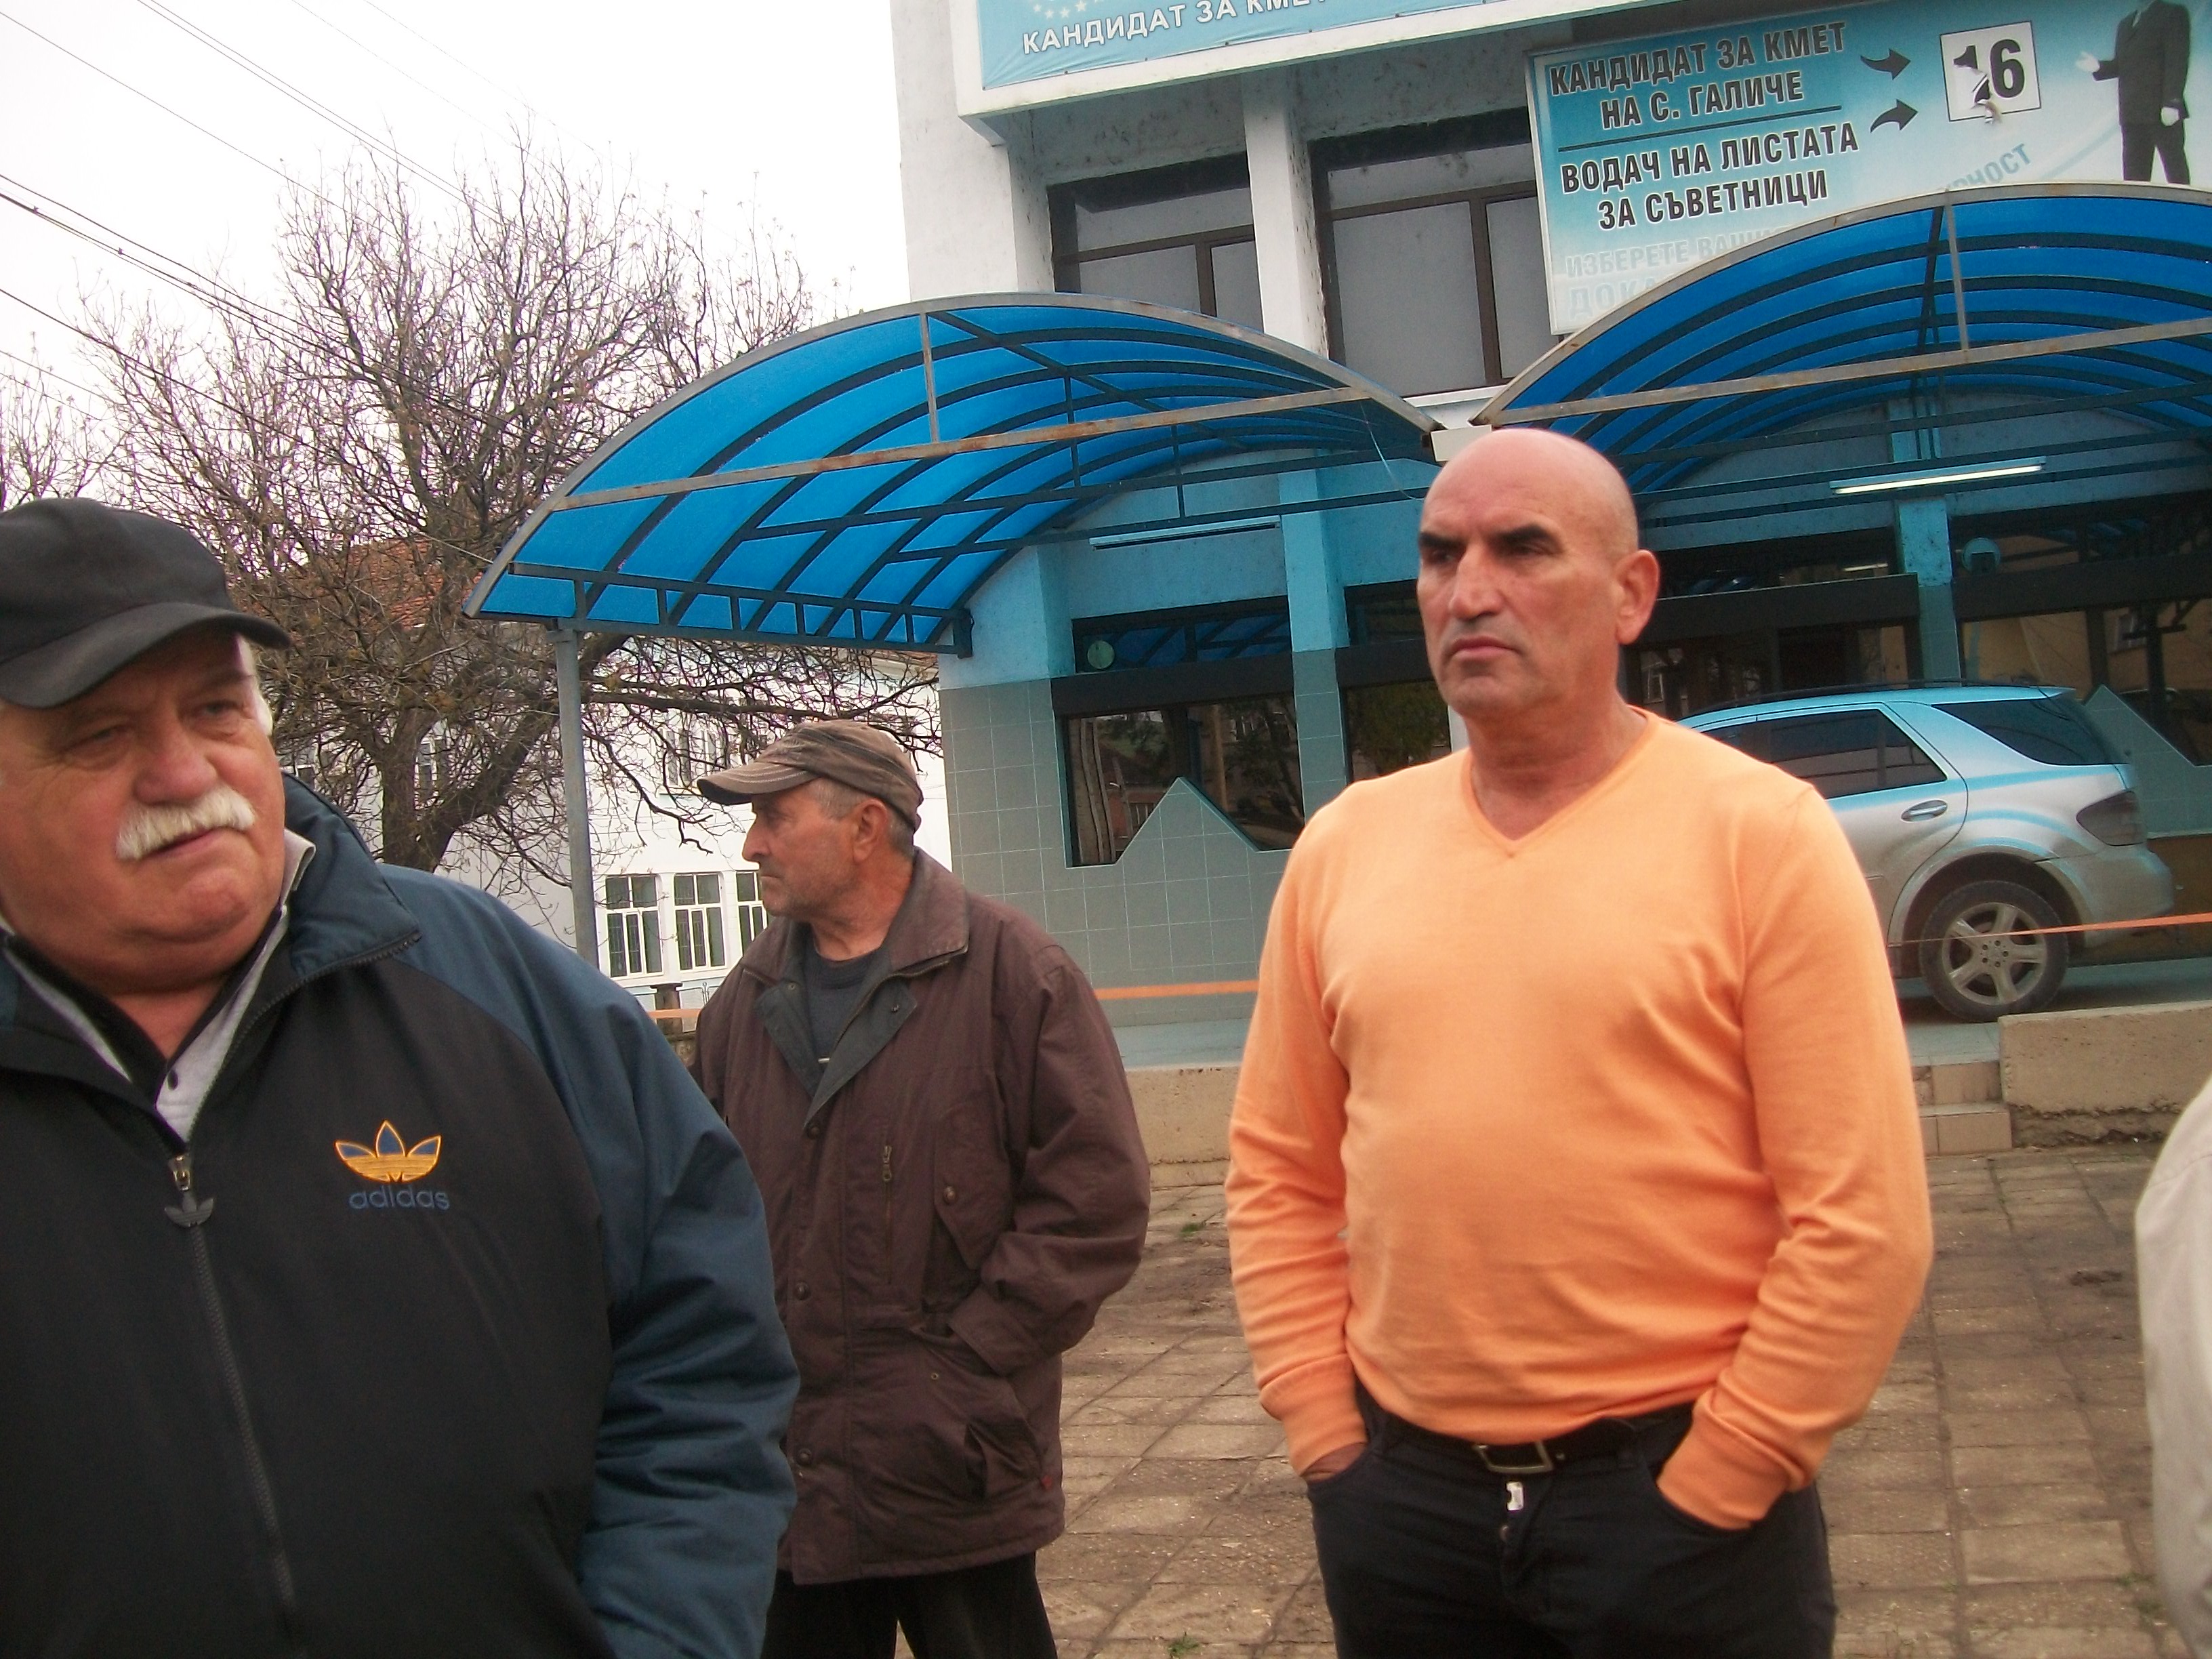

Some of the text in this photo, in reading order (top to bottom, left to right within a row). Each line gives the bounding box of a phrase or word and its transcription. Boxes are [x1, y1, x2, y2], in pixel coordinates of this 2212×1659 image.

[1022, 3, 1187, 54] КАНДИДАТ
[1195, 0, 1237, 23] ЗА
[1550, 22, 1846, 96] КАНДИДАТ ЗА КМЕТ
[1601, 71, 1803, 129] НА С. ГАЛИЧЕ
[1561, 122, 1858, 193] ВОДАЧ НА ЛИСТАТА
[1597, 169, 1828, 230] ЗА СЪВЕТНИЦИ
[1565, 240, 1689, 278] ИЗБЕРЕТЕ
[348, 1185, 450, 1210] adidas
